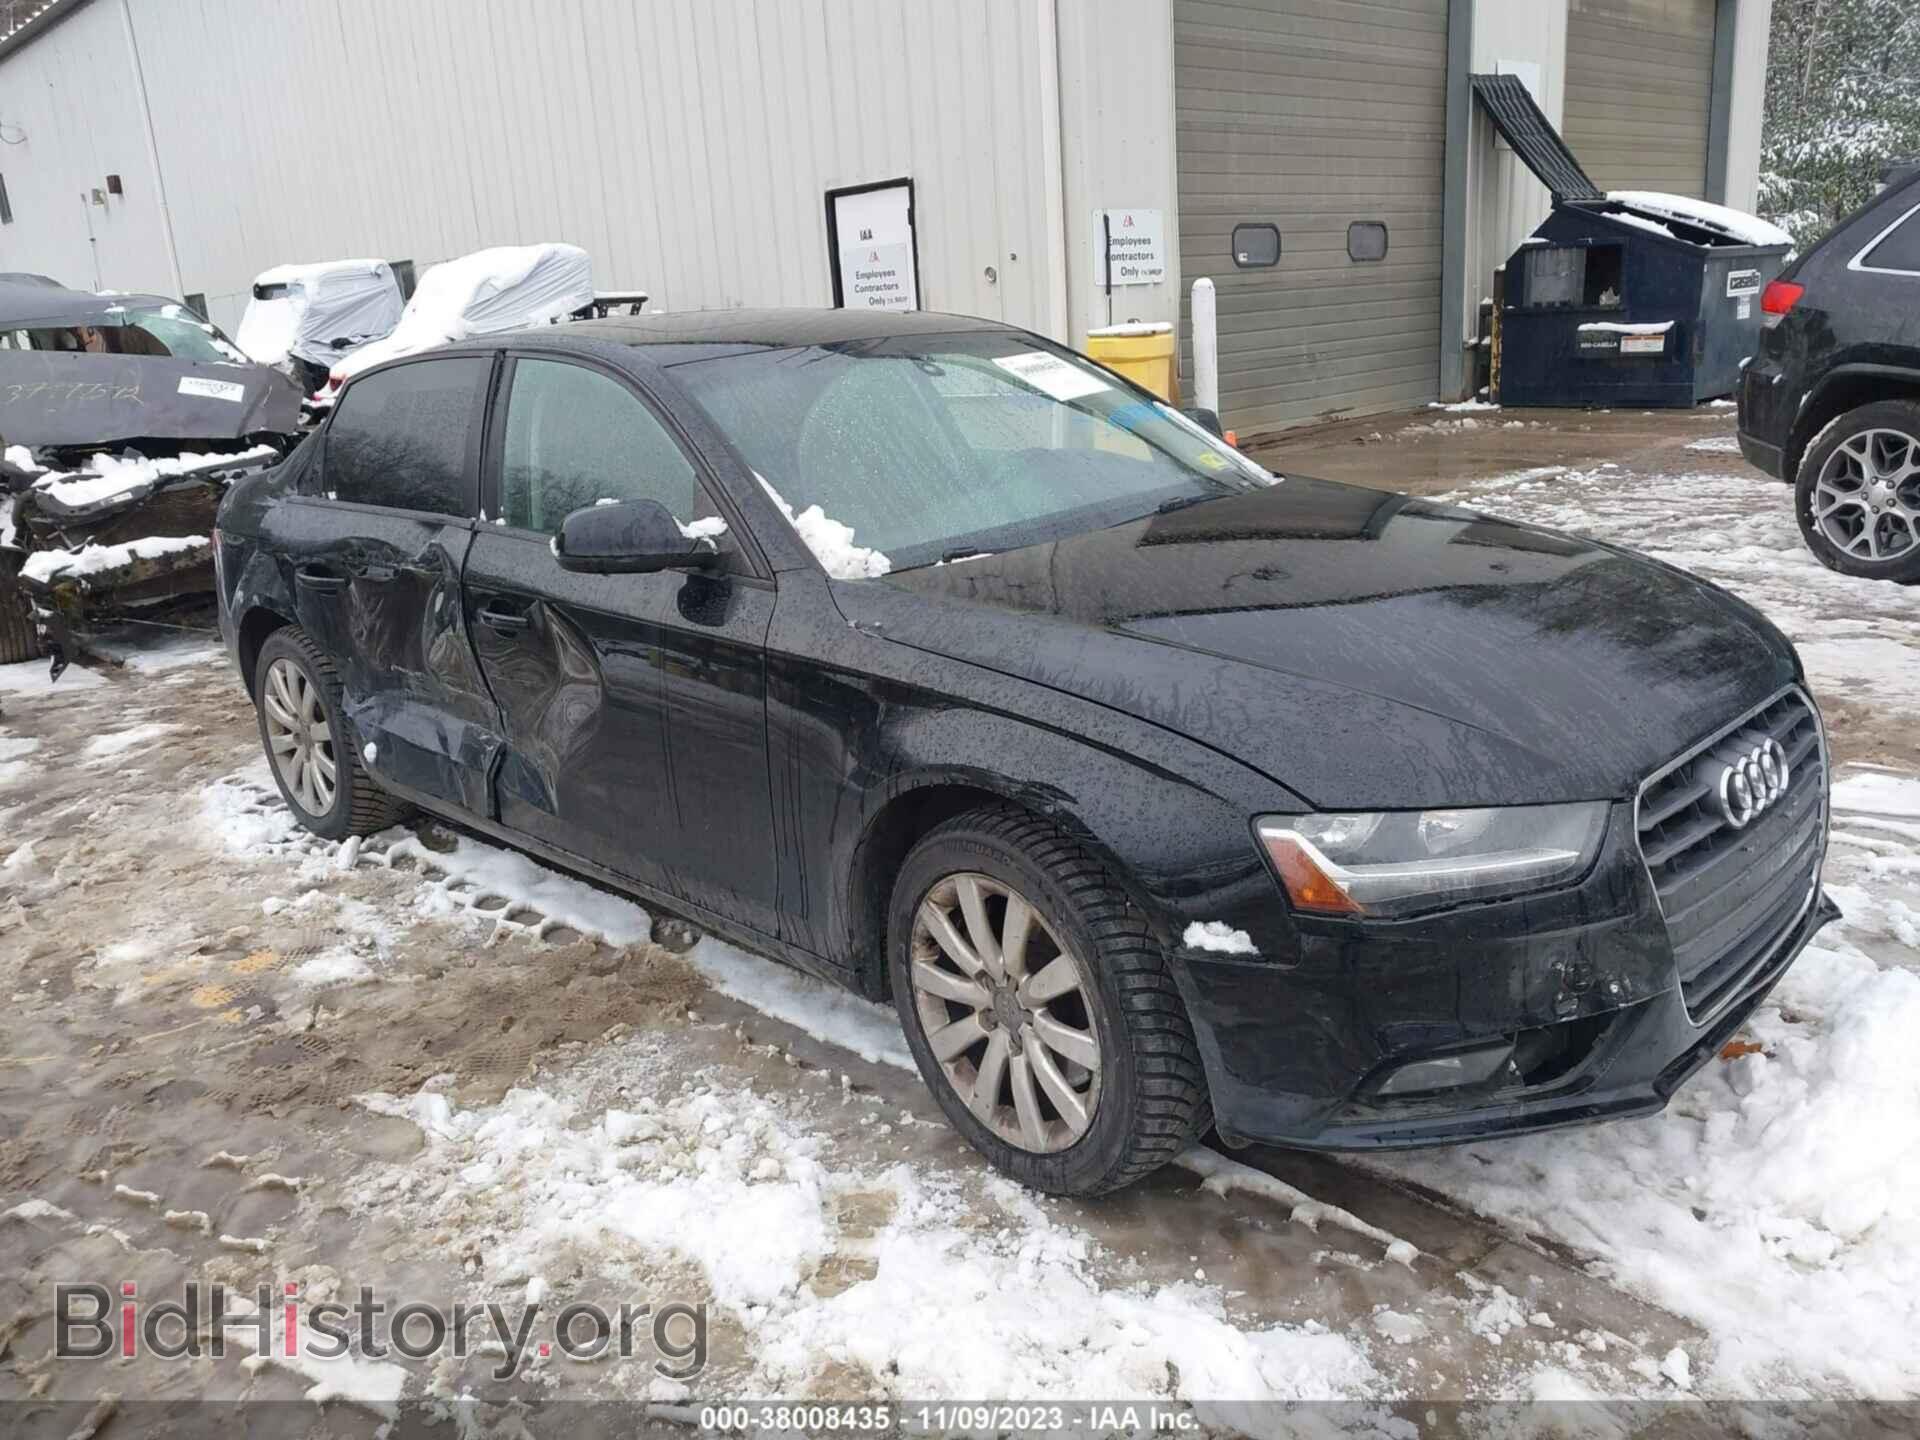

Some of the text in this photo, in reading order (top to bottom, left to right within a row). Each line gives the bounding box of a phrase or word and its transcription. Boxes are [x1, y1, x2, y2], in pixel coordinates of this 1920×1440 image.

[859, 228, 873, 241] IAA
[1108, 251, 1155, 262] ontractors
[855, 269, 896, 281] Employees
[1120, 265, 1139, 278] Only
[854, 283, 899, 294] Contractors
[868, 296, 886, 307] Only
